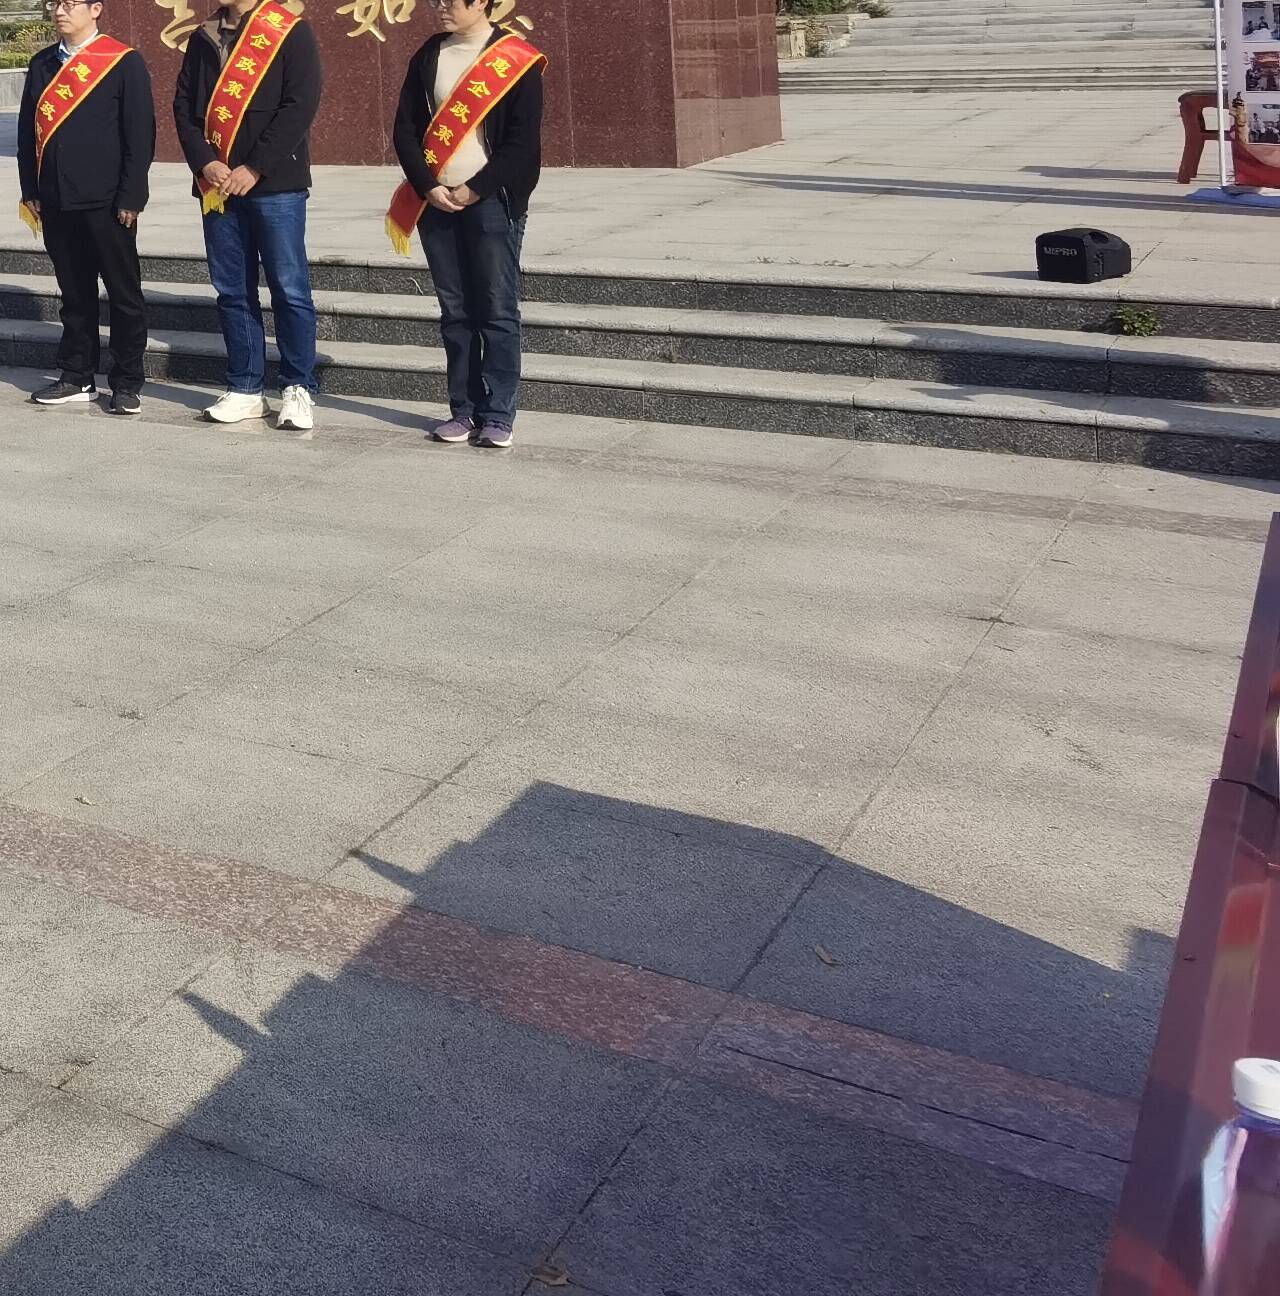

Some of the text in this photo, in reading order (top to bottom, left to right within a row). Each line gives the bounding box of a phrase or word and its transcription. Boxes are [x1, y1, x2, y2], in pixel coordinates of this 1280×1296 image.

[211, 10, 285, 150] 惠企政策专员
[424, 56, 512, 167] 惠企政策专
